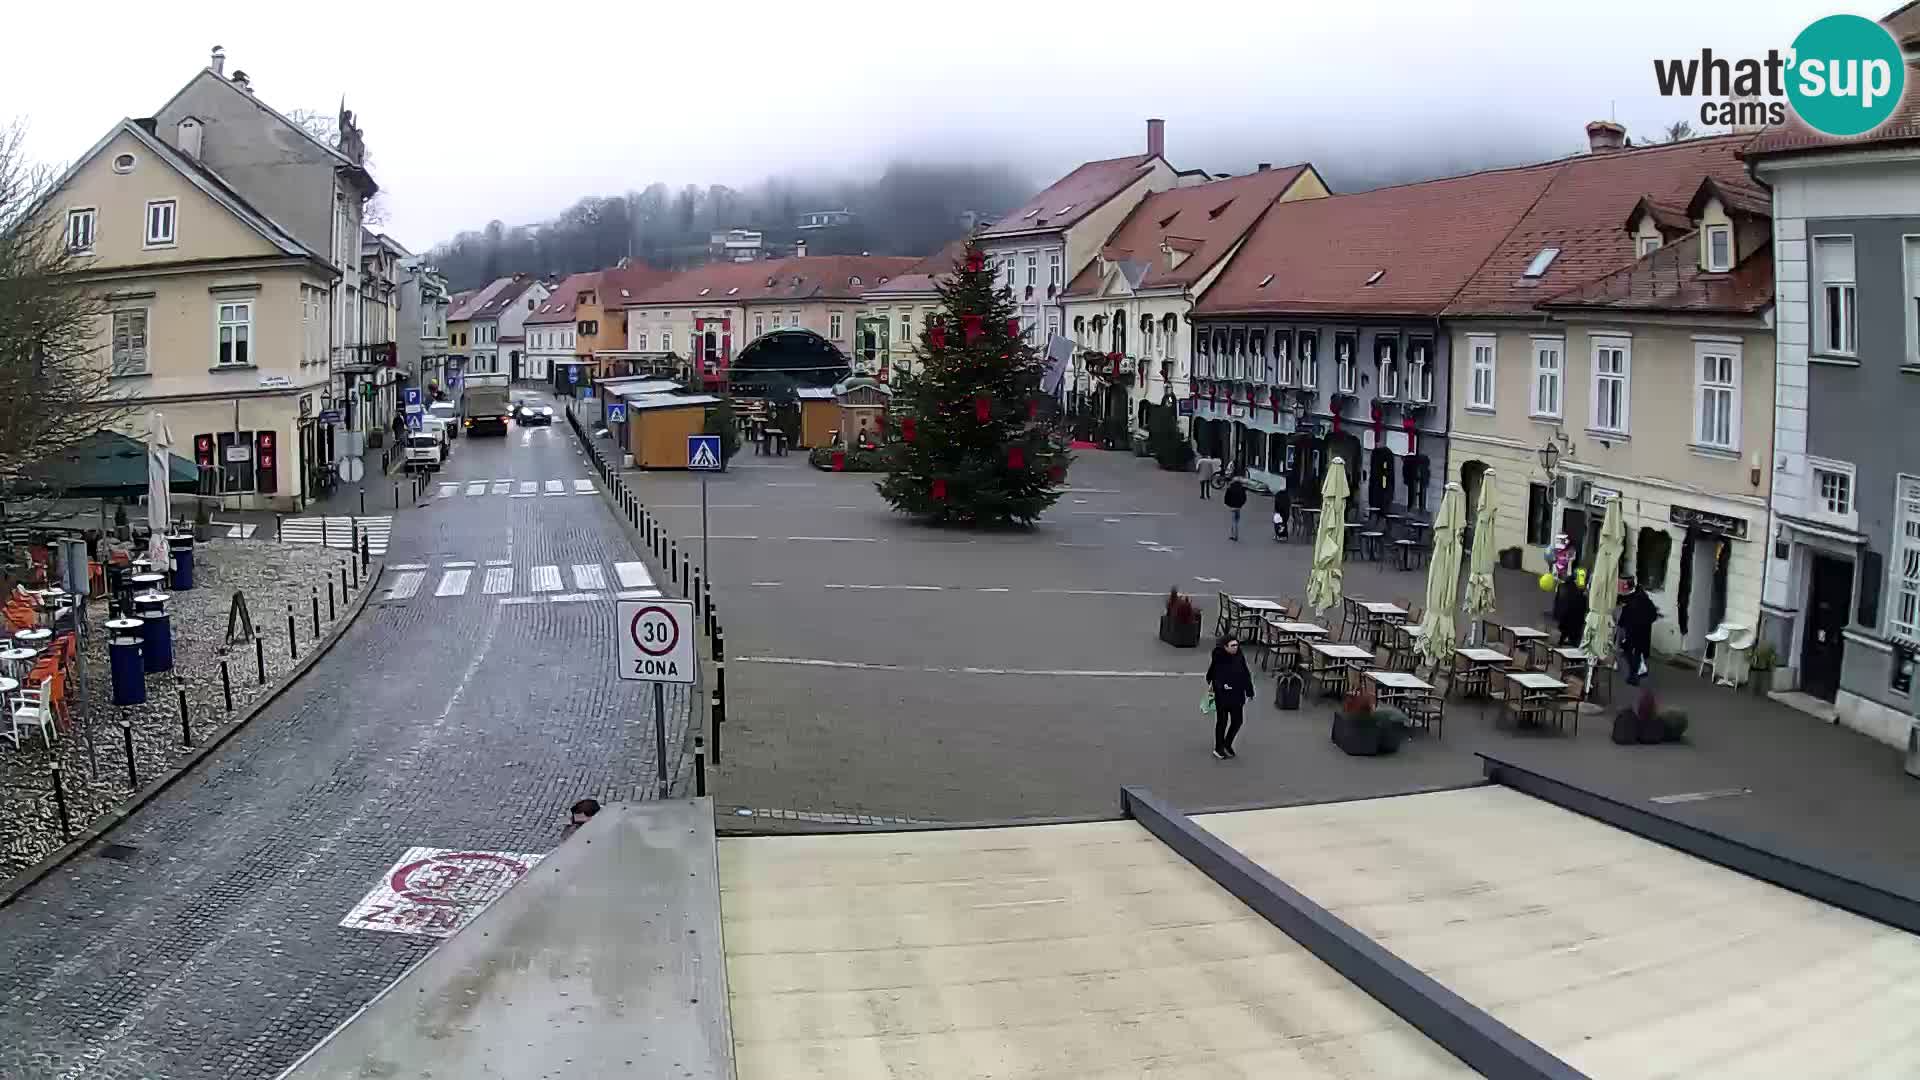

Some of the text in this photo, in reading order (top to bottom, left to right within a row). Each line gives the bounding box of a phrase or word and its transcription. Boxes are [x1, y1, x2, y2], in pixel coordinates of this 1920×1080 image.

[409, 391, 417, 402] P
[643, 622, 667, 642] 30
[634, 660, 678, 675] ZONA
